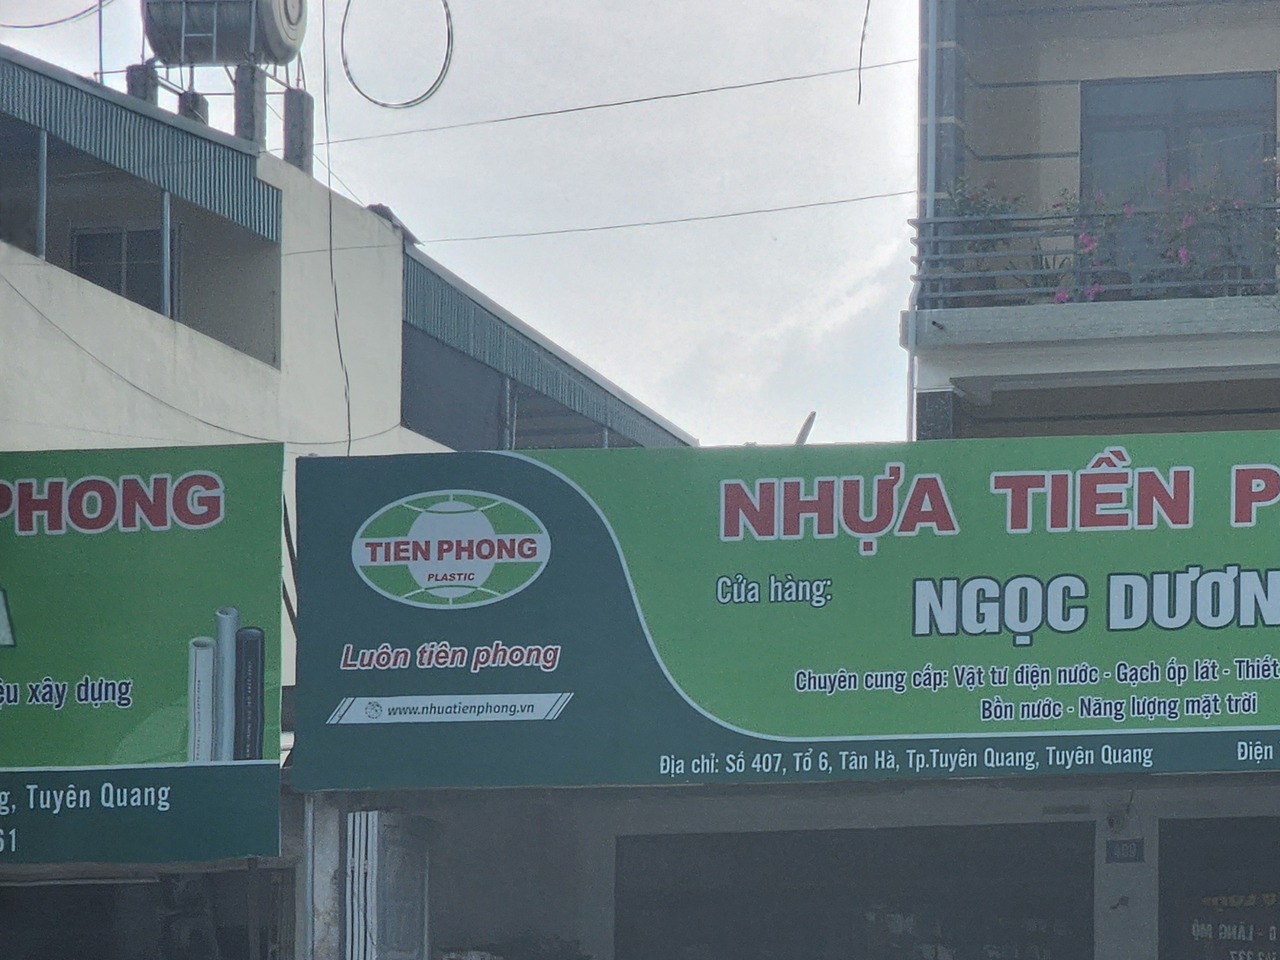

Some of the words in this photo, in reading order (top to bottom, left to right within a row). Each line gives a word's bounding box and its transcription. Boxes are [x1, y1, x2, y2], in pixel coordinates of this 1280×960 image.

[0, 470, 225, 535] HONG
[720, 462, 960, 556] NHỰA
[990, 446, 1194, 534] TIỀN
[365, 540, 431, 562] TIEN
[437, 538, 538, 561] PHONG
[427, 572, 475, 582] PLASTIC
[716, 573, 761, 605] Cửa
[768, 574, 833, 608] hàng:
[912, 574, 1089, 648] NGỌC
[340, 642, 411, 670] Luôn
[417, 641, 467, 668] tiên
[471, 640, 561, 673] phong
[795, 667, 858, 695] Chuyên
[864, 669, 906, 693] cung
[912, 663, 948, 691] cấp:
[954, 664, 985, 690] Vật
[989, 666, 1008, 687] tư
[1014, 663, 1051, 689] điện
[1057, 663, 1099, 685] nước
[1116, 660, 1160, 687] Gạch
[1166, 657, 1187, 685] ốp
[1194, 657, 1219, 681] lát
[1234, 656, 1280, 680] Thiết
[26, 675, 68, 710] xây
[76, 675, 133, 709] dựng
[981, 695, 1014, 721] Bồn
[1020, 698, 1062, 719] nước
[1079, 697, 1125, 722] Năng
[1130, 695, 1179, 720] lượng
[1185, 693, 1221, 719] mặt
[1226, 691, 1258, 714] trời
[387, 702, 535, 717] www.nhuatienphong.vn
[659, 755, 685, 778] Địa
[691, 752, 719, 774] chỉ:
[725, 750, 745, 773] Số
[751, 752, 787, 775] 407,
[793, 748, 812, 772] Tổ
[818, 751, 833, 774] 6,
[839, 750, 868, 771] Tân
[874, 749, 900, 772] Hà,
[906, 748, 977, 772] Tp.Tuyên
[984, 747, 1039, 771] Quang,
[1046, 746, 1094, 770] Tuyên
[1101, 744, 1153, 767] Quang
[1237, 740, 1274, 764] Điện
[26, 784, 91, 815] Tuyên
[100, 782, 170, 811] Quang
